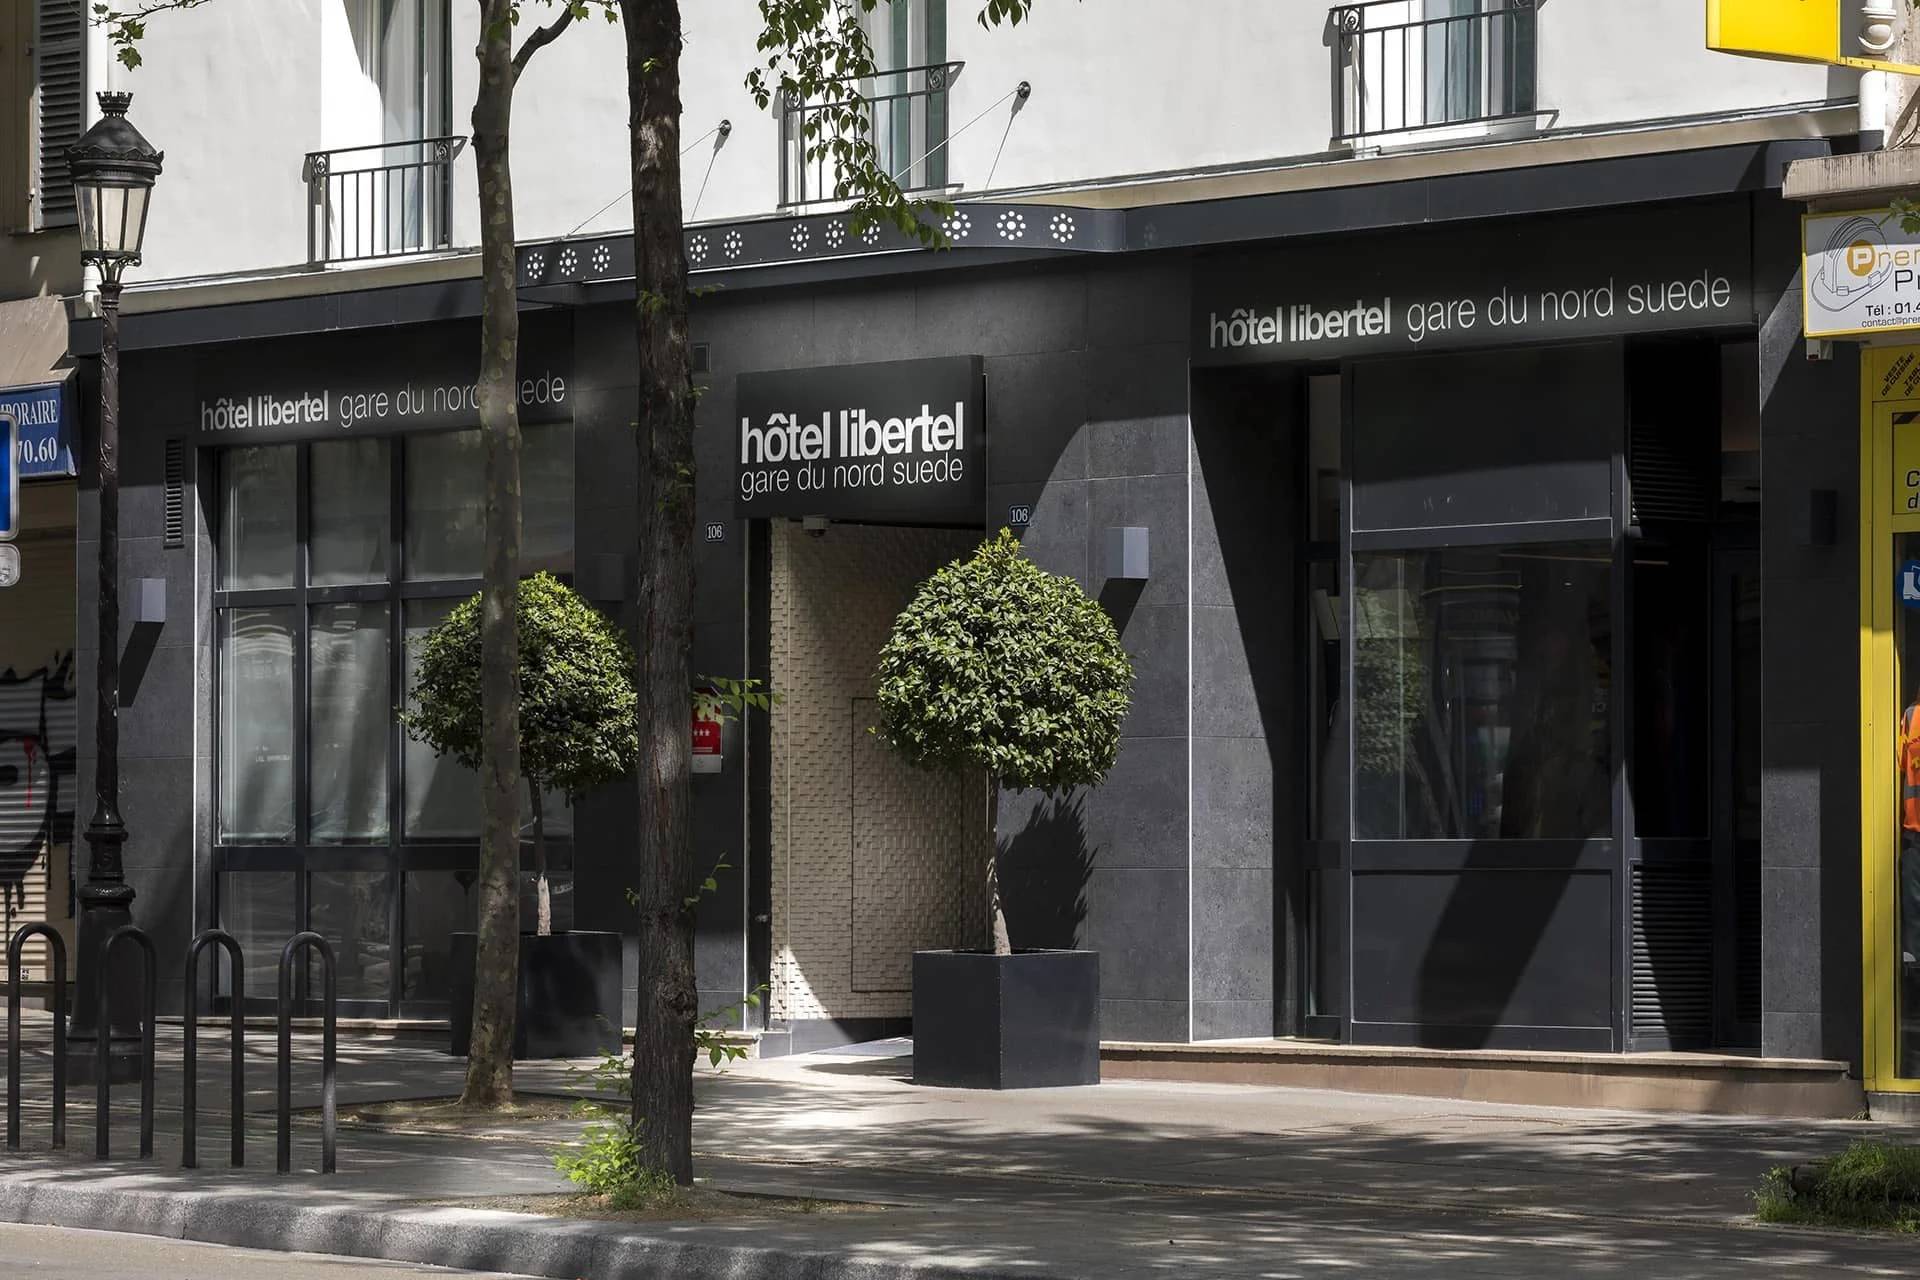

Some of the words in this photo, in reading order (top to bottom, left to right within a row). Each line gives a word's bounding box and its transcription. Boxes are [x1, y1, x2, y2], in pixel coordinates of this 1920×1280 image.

[1895, 269, 1920, 292] P
[1209, 306, 1283, 349] hôtel
[1289, 297, 1391, 342] libertel
[1407, 299, 1476, 343] gare
[1487, 286, 1527, 326] du
[1541, 277, 1614, 321] nord
[1627, 269, 1731, 315] suede
[201, 397, 252, 432] hôtel
[257, 390, 329, 427] libertel
[339, 391, 389, 429] gare
[397, 382, 424, 416] du
[516, 369, 566, 406] ede
[741, 410, 832, 465] hôtel
[839, 401, 964, 458] libertel
[741, 468, 790, 502] gare
[797, 460, 826, 492] du
[833, 456, 885, 489] nord
[892, 452, 964, 485] suede
[707, 524, 723, 539] 106
[1011, 508, 1028, 523] 106
